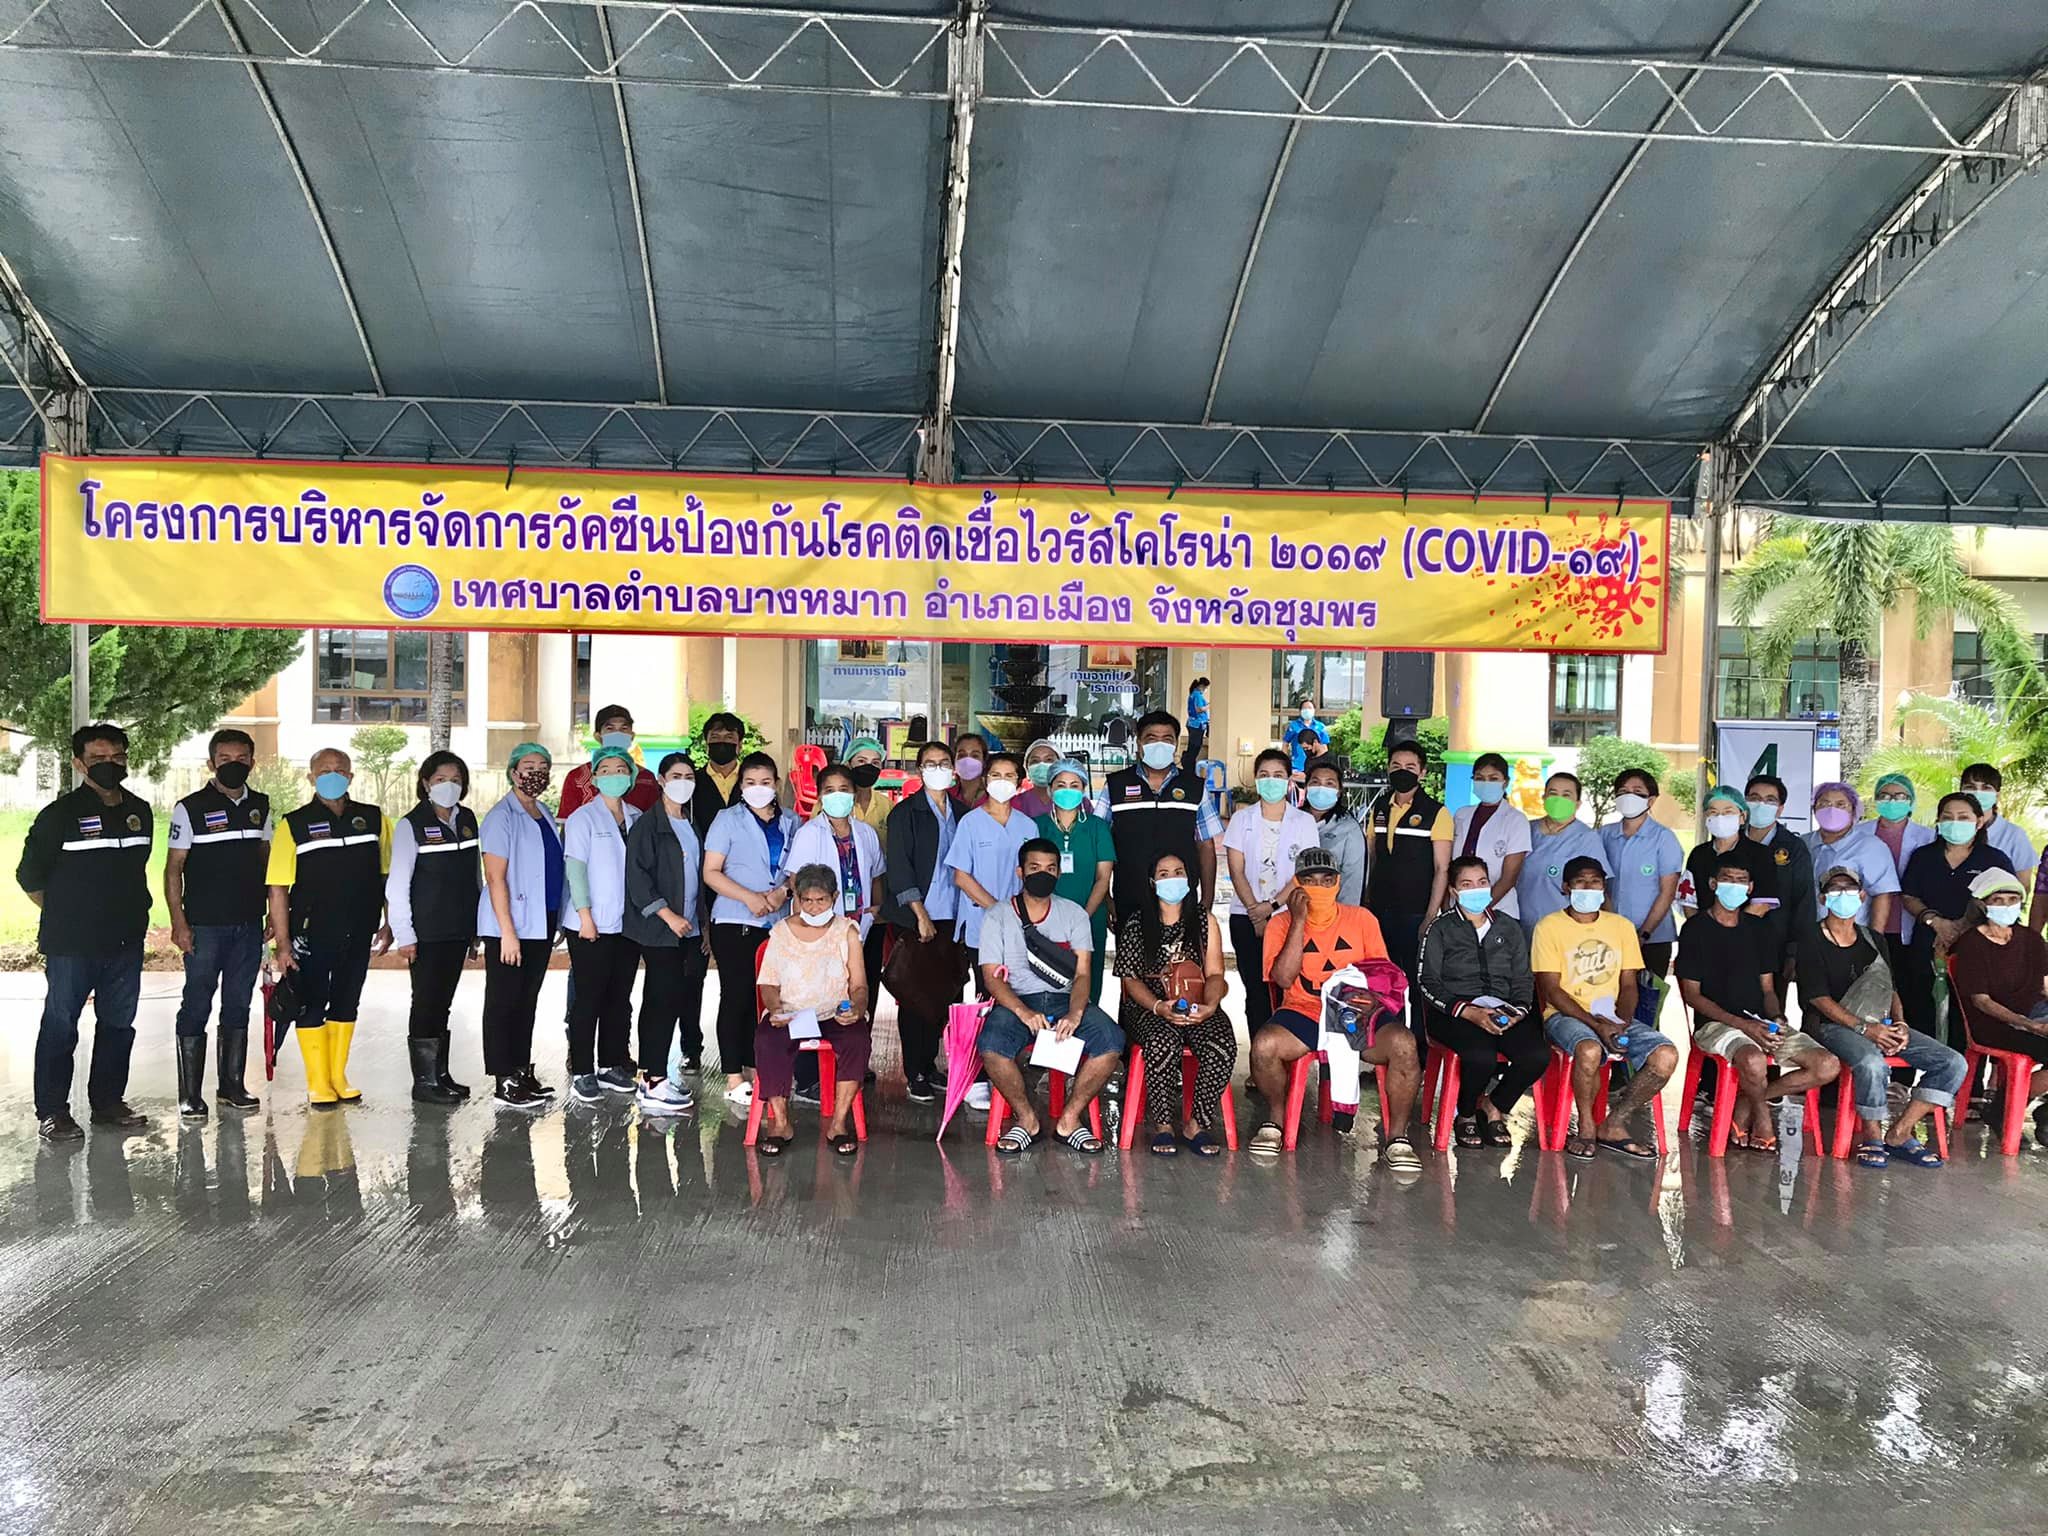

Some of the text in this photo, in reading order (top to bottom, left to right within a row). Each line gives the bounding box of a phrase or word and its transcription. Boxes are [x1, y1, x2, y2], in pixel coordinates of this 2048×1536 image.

[79, 481, 1640, 582] โครงการบริหารจัดการวัคซีนป้องกันโรคติดเชื้อไวรัสโคโรน่า ๒๐๑๙ (COVID-๑๙)
[453, 572, 908, 618] เทศบาลตำบลบางหมาก
[925, 577, 1132, 624] อำเภอเมือง
[1148, 584, 1377, 643] จังหวัดชุมพร
